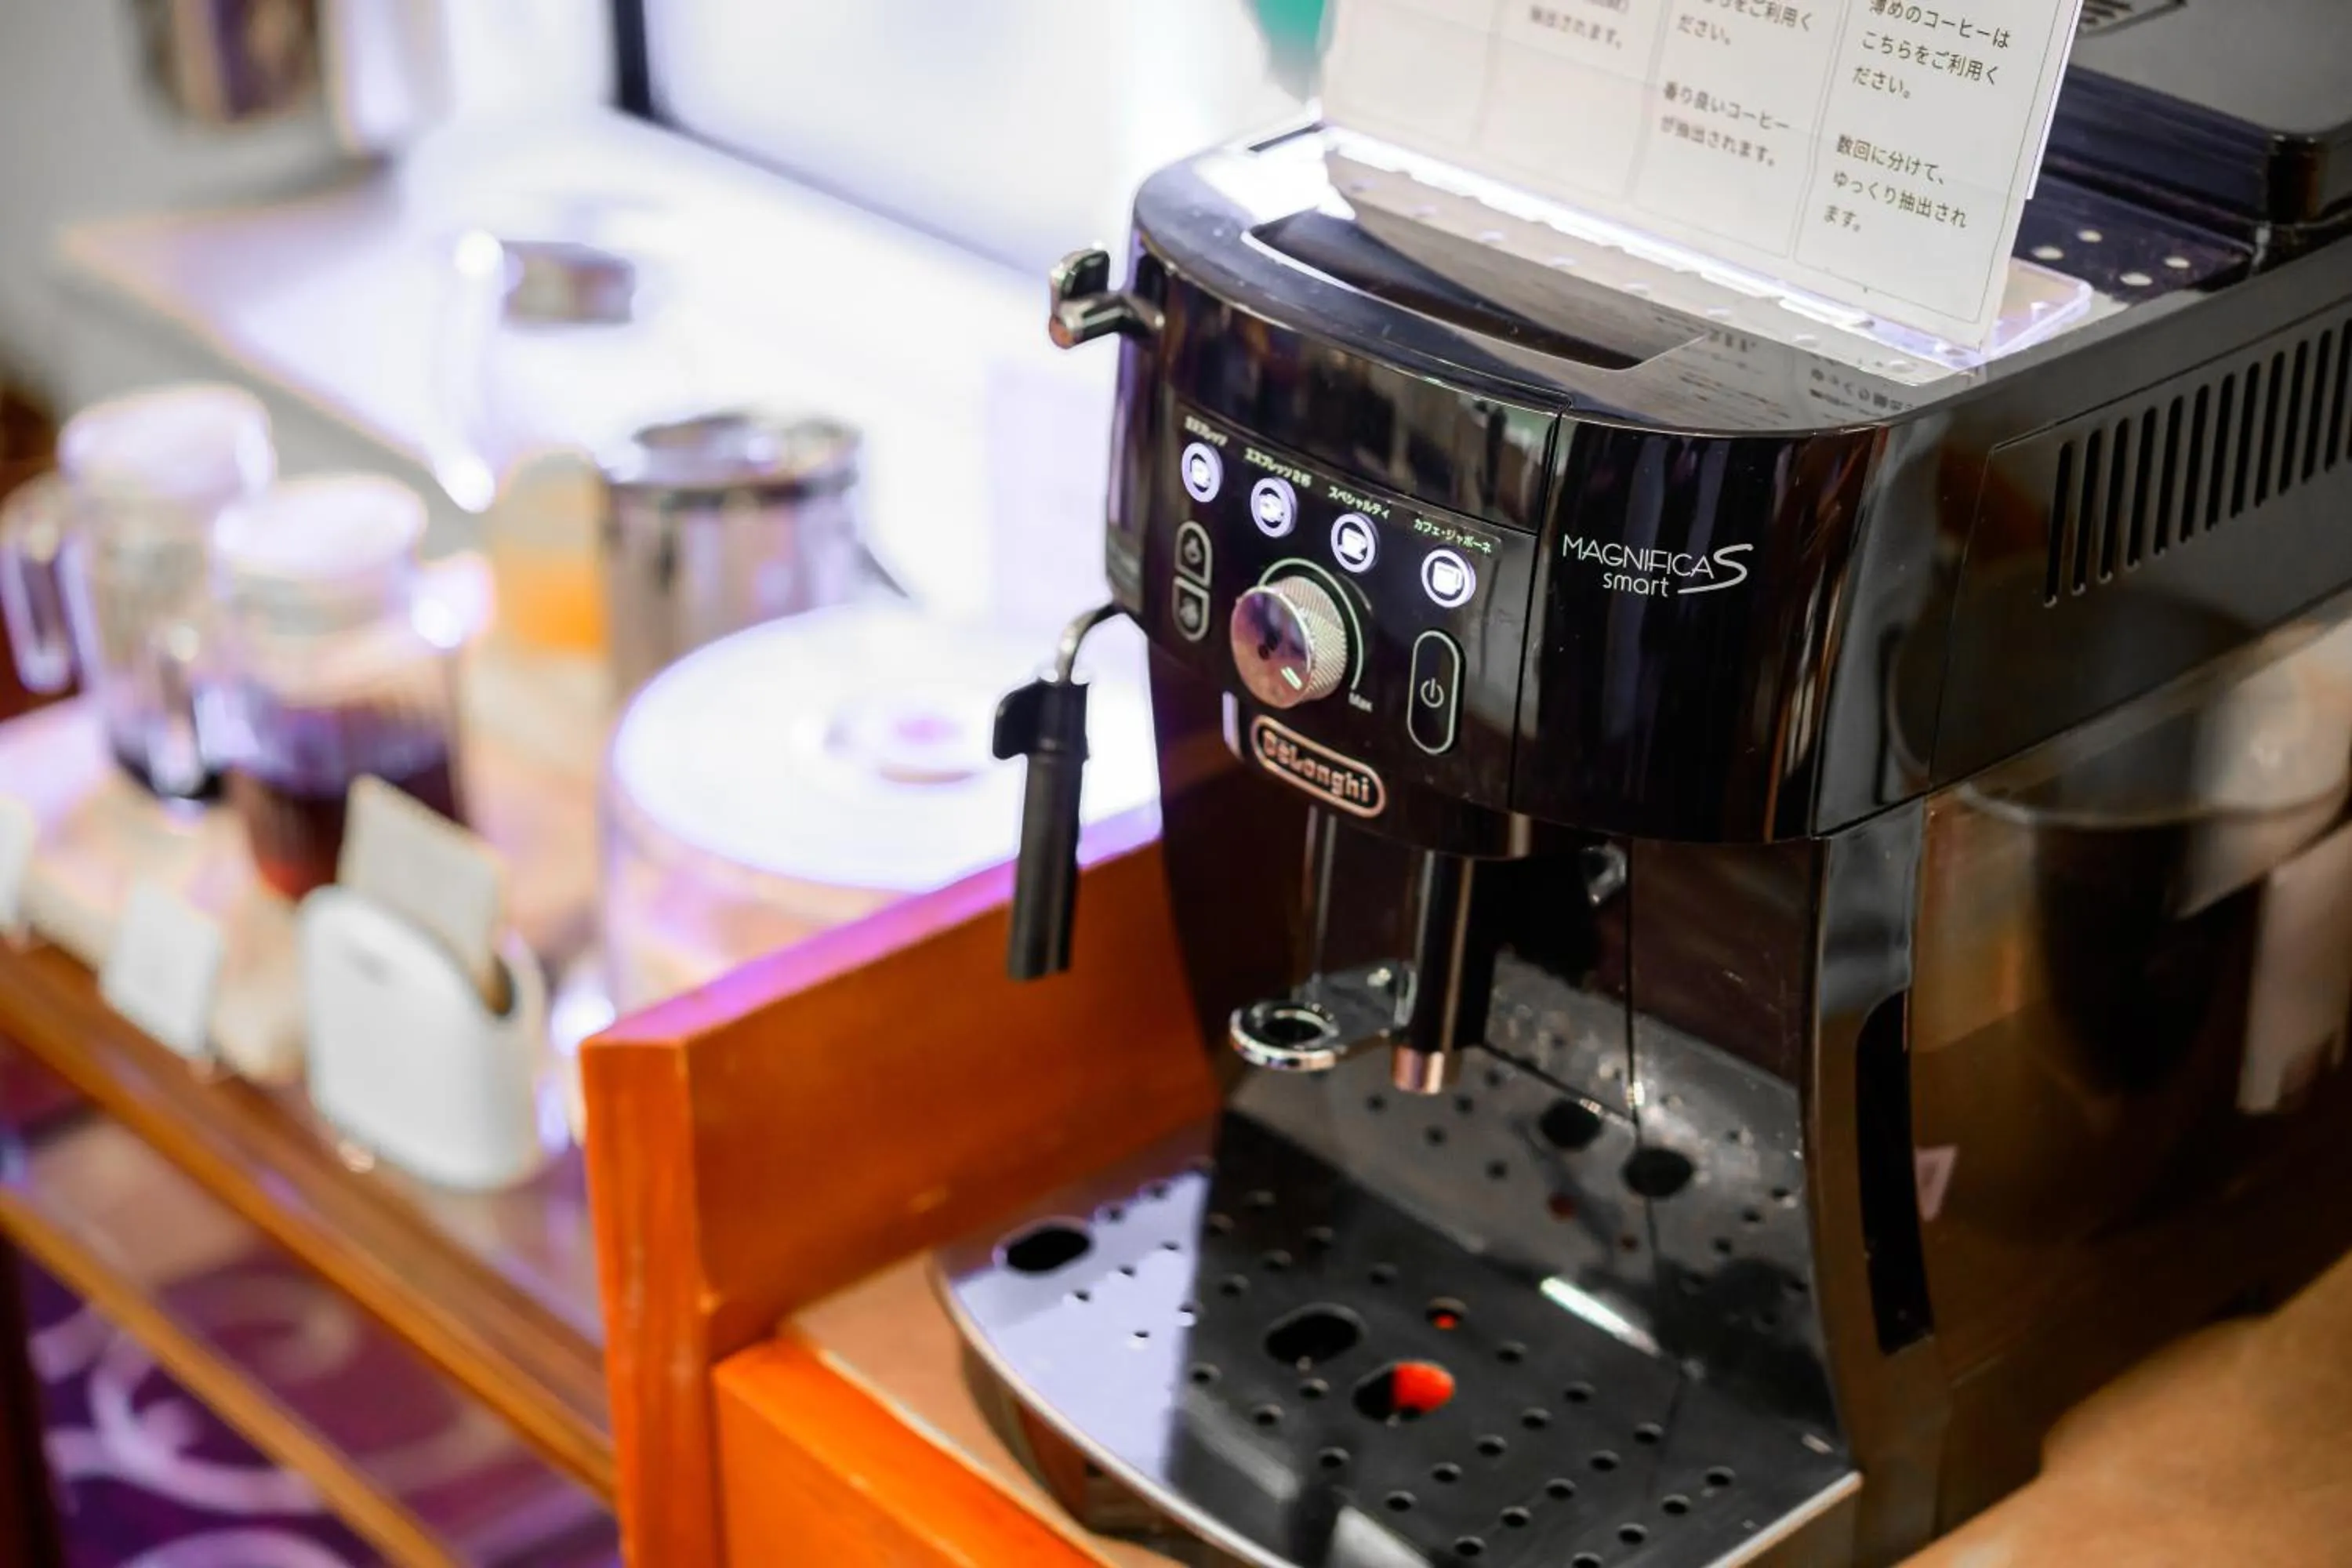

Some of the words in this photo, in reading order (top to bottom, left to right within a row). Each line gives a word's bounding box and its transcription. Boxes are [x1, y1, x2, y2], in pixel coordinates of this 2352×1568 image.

[1860, 30, 1998, 85] こちらをご利用く
[1852, 65, 1911, 99] ださい。
[1835, 134, 1944, 185] 数回に分けて、
[1832, 170, 1967, 229] ゆっくり抽出され
[1414, 517, 1492, 554] カフェ・ジャポーネ
[1563, 533, 1715, 580] MAGNIFICA
[1602, 572, 1669, 598] smart
